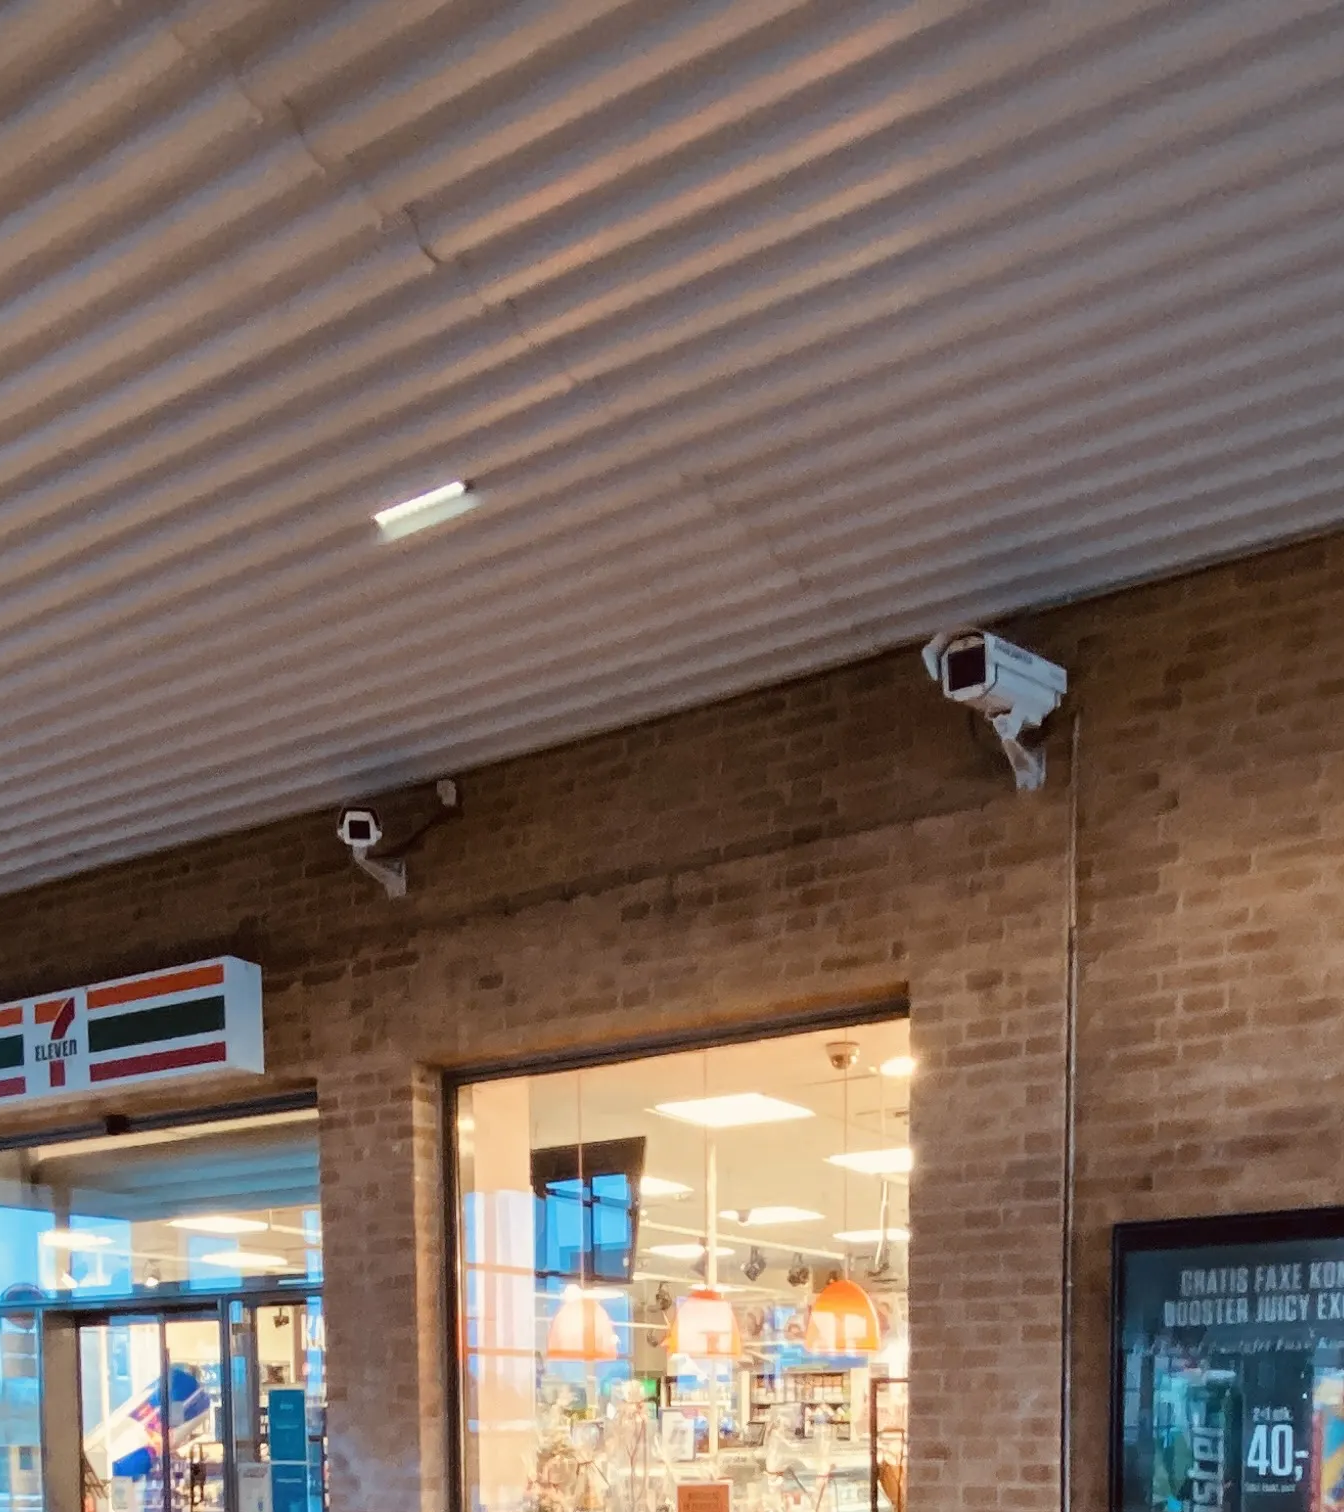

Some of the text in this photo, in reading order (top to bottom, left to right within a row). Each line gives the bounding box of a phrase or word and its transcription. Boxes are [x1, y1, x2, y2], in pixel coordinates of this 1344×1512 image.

[35, 997, 75, 1087] 7
[1180, 1268, 1248, 1296] GRATIS
[1255, 1263, 1302, 1292] FAXE
[1164, 1298, 1248, 1327] BOOSTER
[1256, 1294, 1310, 1323] JUICY
